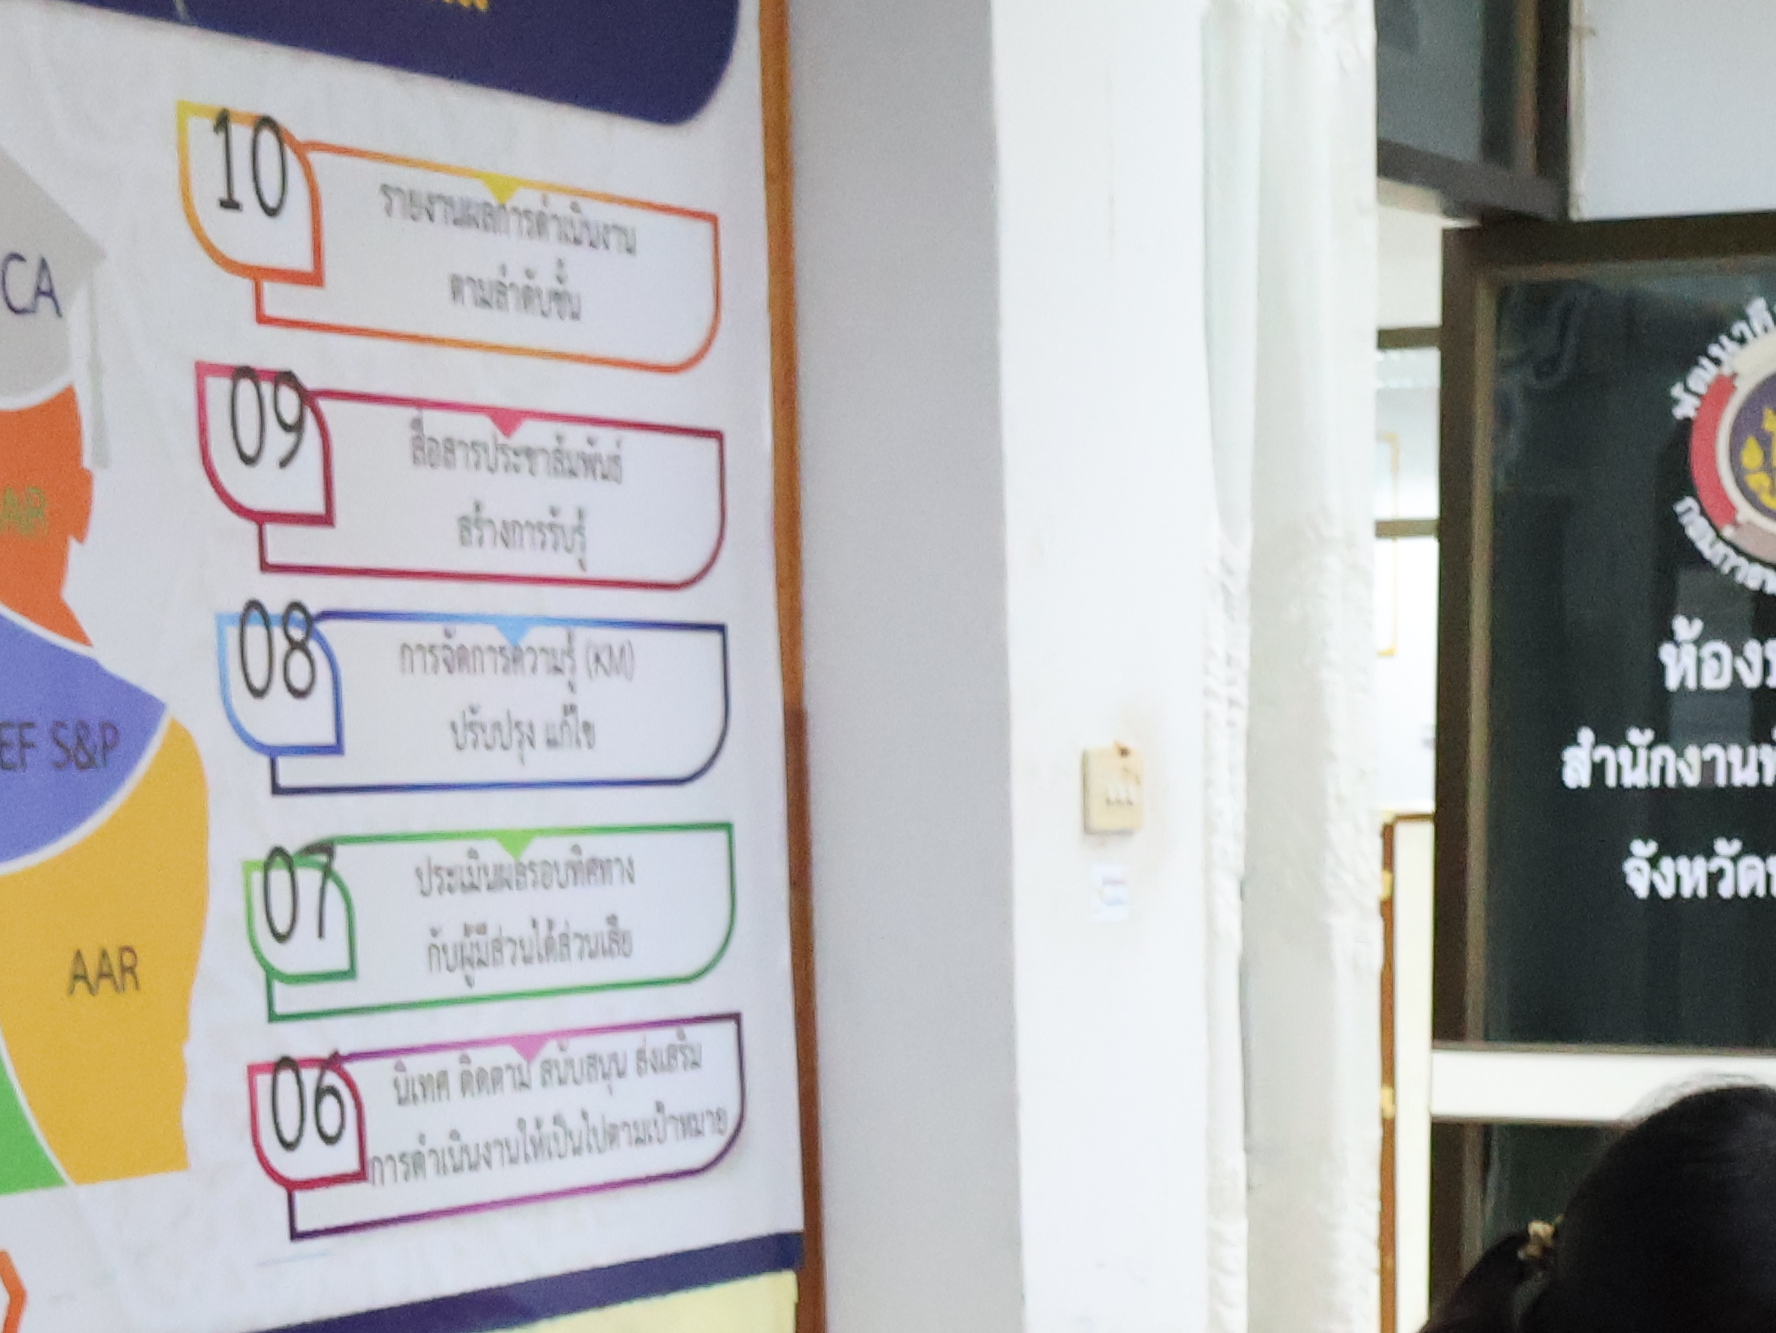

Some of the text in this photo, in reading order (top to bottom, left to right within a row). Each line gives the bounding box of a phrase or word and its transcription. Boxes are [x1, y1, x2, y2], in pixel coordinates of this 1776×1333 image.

[213, 107, 288, 218] 10
[230, 365, 307, 469] 09
[239, 598, 316, 699] 08
[49, 719, 121, 771] S&P
[263, 839, 336, 944] 07
[67, 944, 141, 997] AAR
[272, 1048, 346, 1152] 06
